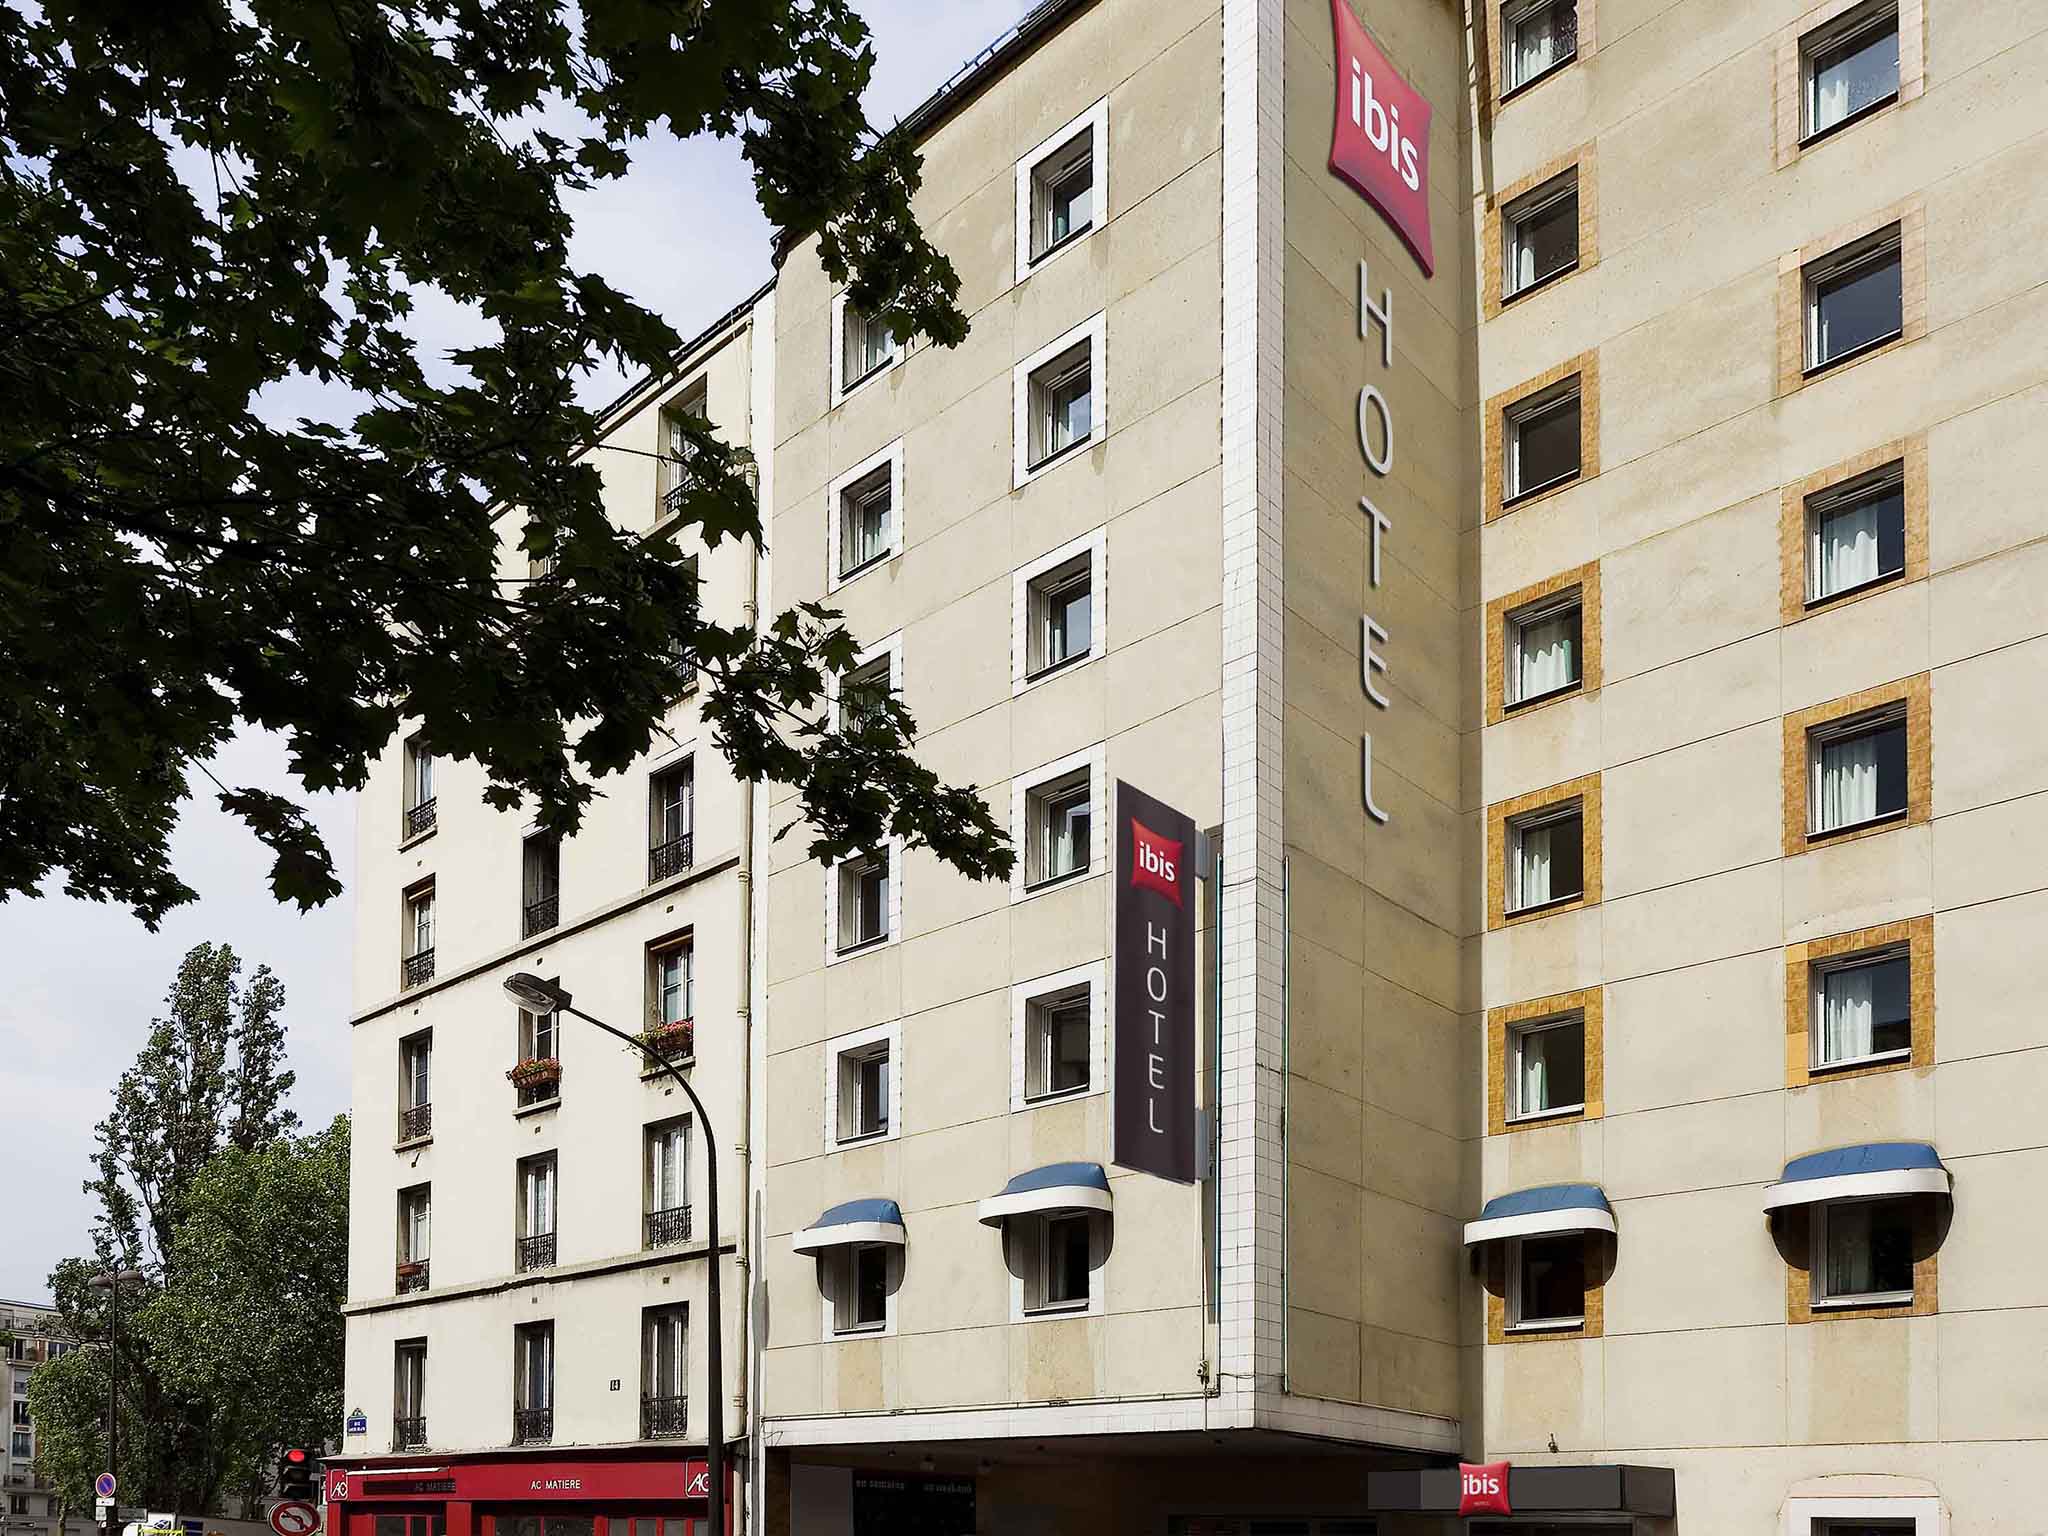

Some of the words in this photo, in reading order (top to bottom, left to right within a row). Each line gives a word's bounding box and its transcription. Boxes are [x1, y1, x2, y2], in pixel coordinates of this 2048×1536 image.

[1352, 55, 1420, 192] ibis
[1359, 257, 1393, 824] HOTEL
[1139, 840, 1175, 882] ibis
[1146, 921, 1168, 1134] HOTEL
[531, 1480, 542, 1490] AC
[545, 1479, 581, 1490] MATIERE
[1463, 1472, 1500, 1495] ibis
